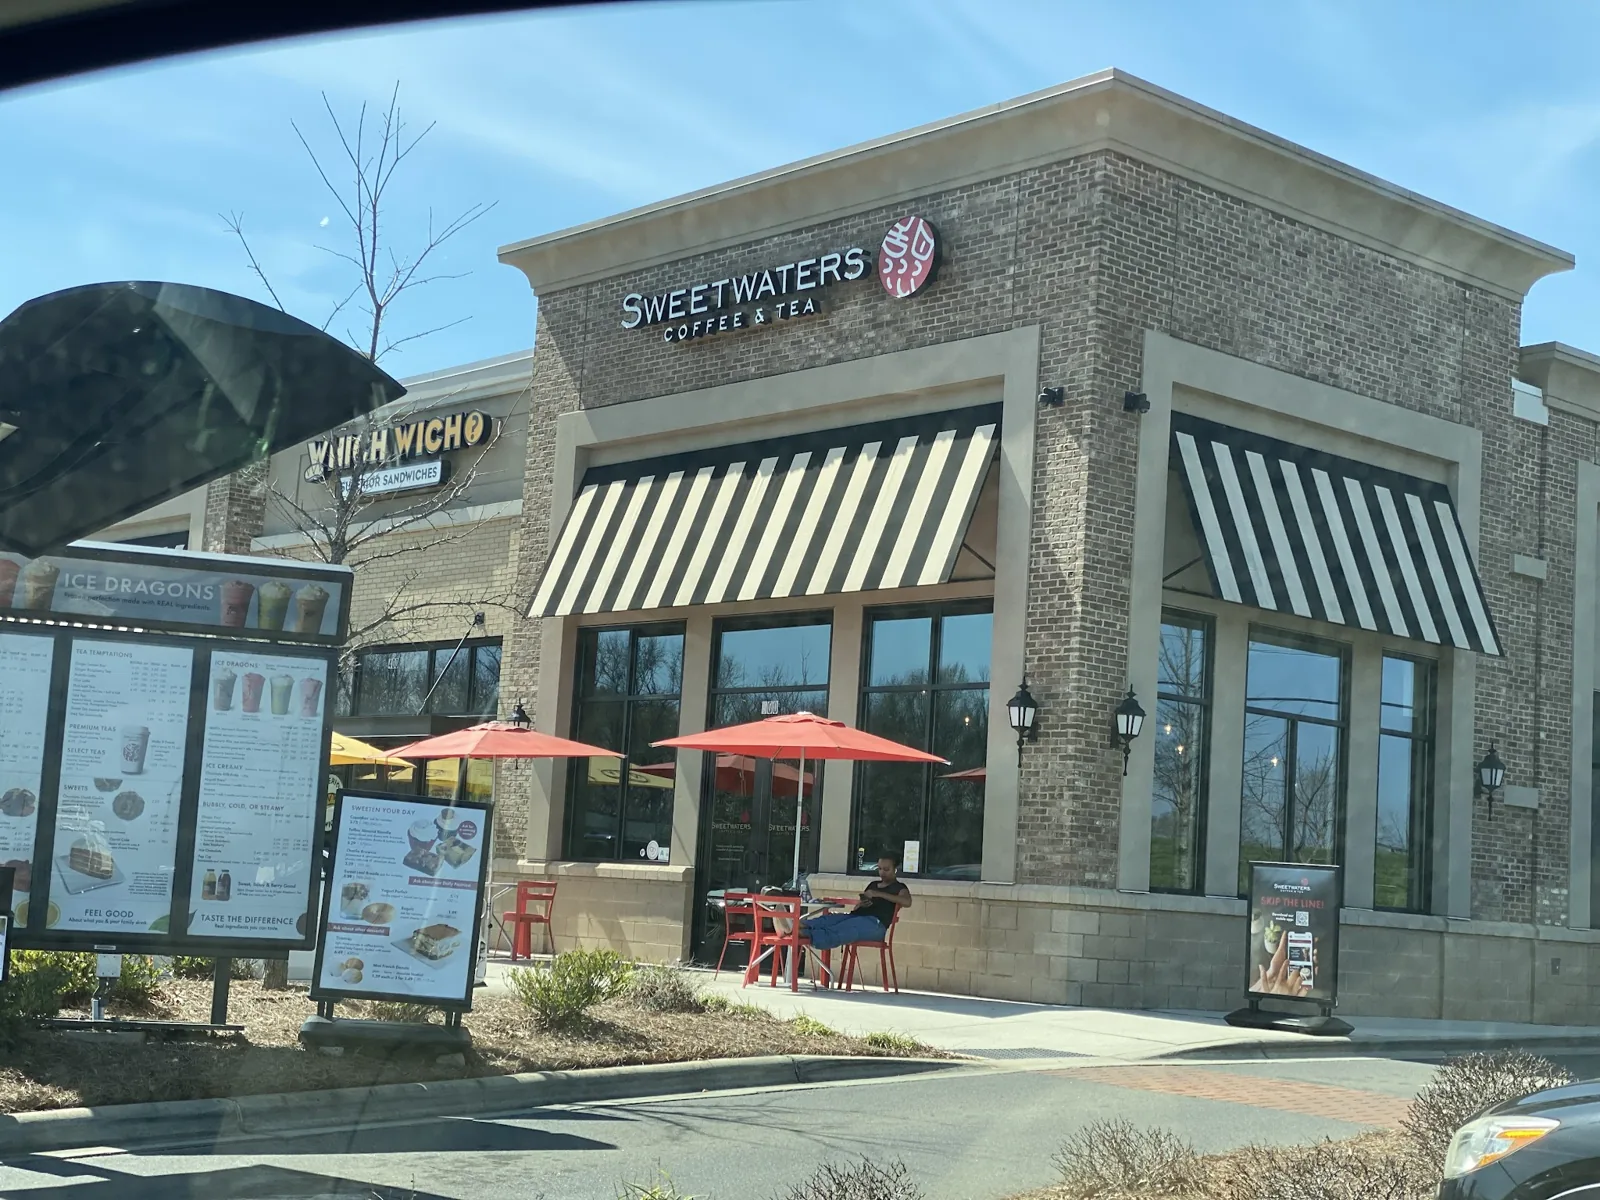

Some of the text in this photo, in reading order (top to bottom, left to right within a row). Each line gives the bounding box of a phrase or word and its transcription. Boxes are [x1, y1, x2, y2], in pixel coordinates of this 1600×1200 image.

[621, 248, 865, 329] SWEETWATERS
[663, 297, 815, 342] COFFEE & TEA
[383, 466, 438, 486] SANDWICHES
[64, 573, 215, 601] ICE DRAGONS
[122, 597, 141, 605] made
[157, 600, 174, 608] REAL
[69, 723, 117, 733] PREMIUM TEAS
[67, 747, 106, 756] SELECT TEAS
[205, 762, 216, 770] ICE
[260, 804, 285, 812] STEAMY
[351, 804, 416, 816] SWEETEN YOUR DAY
[711, 822, 752, 830] SWEETWATERS
[768, 823, 811, 832] SWEETWAERS
[1260, 896, 1325, 909] SKIP THE LINE!
[84, 908, 134, 919] FEEL GOOD
[200, 914, 294, 925] TASTE THE DIFFERENCE
